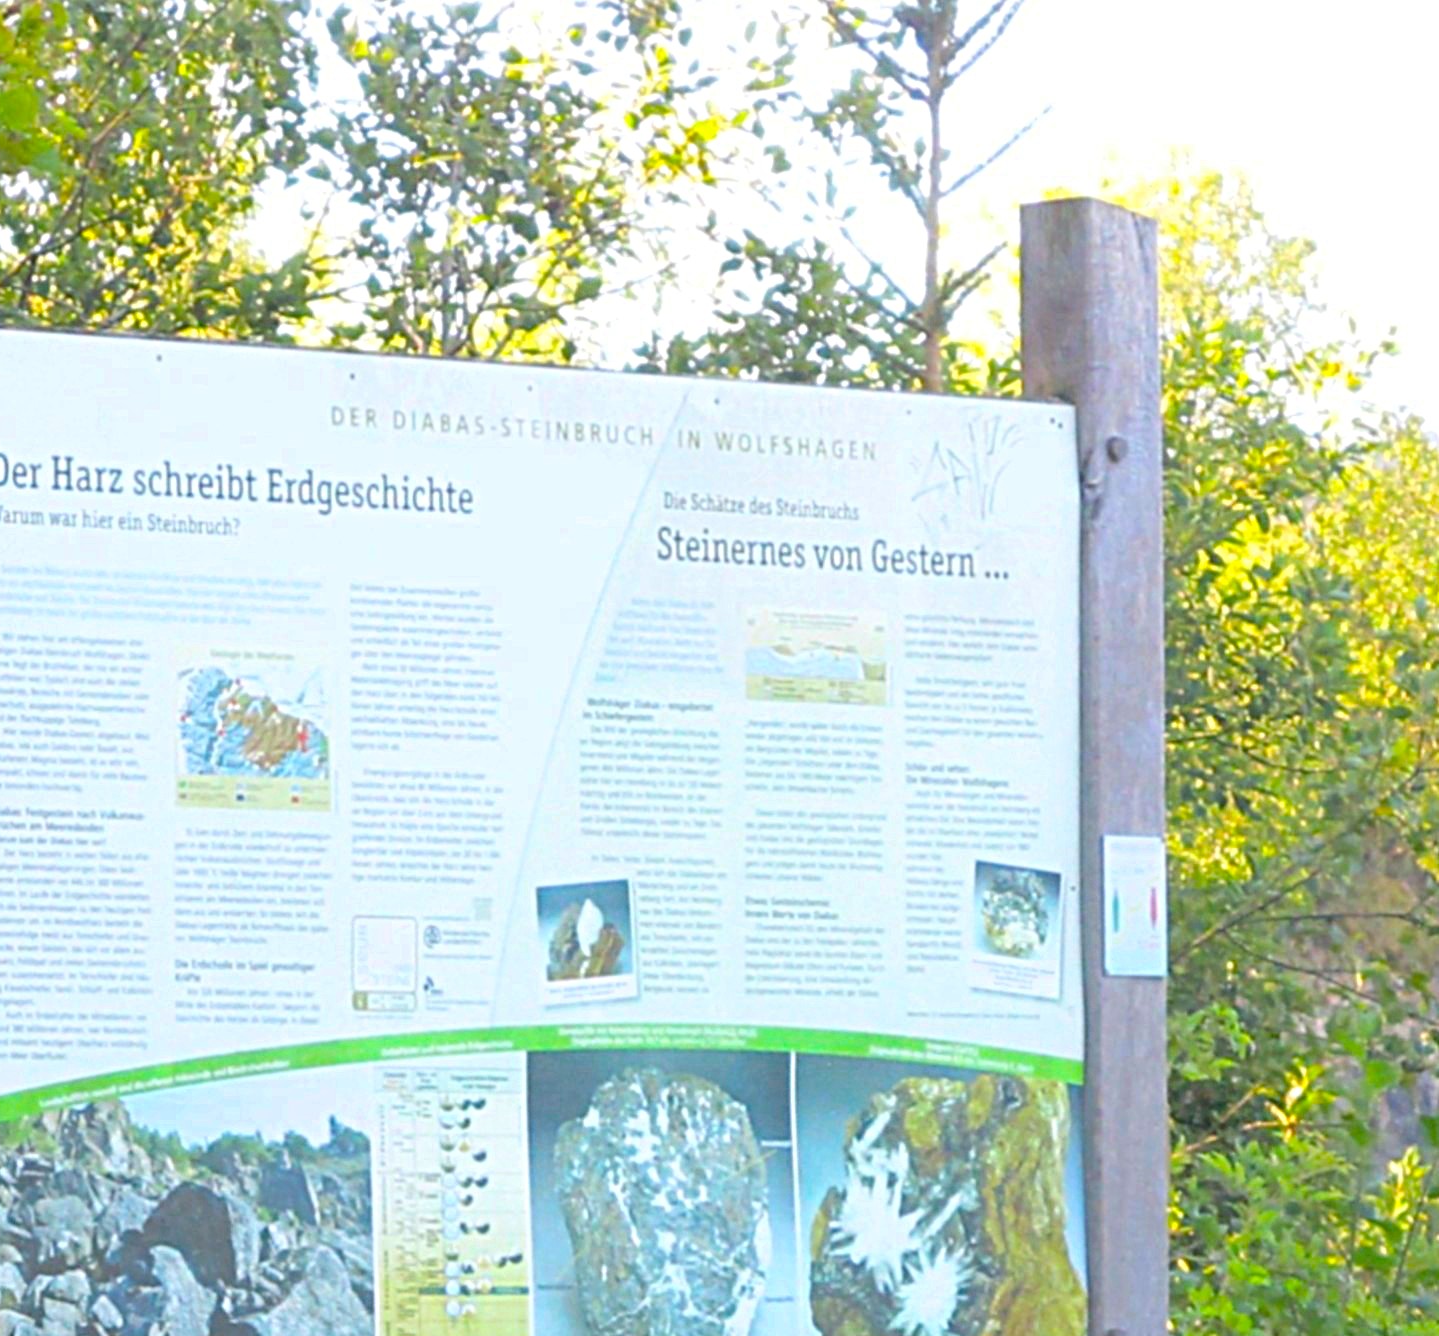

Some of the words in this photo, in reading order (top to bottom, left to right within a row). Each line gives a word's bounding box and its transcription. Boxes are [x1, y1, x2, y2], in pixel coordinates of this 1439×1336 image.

[331, 406, 377, 428] DER
[393, 410, 653, 446] DIABAS-STEINBRUCH
[677, 430, 700, 449] IN
[714, 431, 876, 460] WOLFSHAGEN
[51, 455, 124, 494] Harz
[133, 460, 258, 501] schreibt
[267, 468, 474, 515] Erdgeschichte
[664, 492, 687, 509] Die
[691, 493, 744, 514] Schätze
[750, 497, 772, 515] des
[776, 499, 859, 520] Steinbruchs
[49, 511, 77, 527] war
[82, 509, 112, 529] hier
[118, 512, 143, 531] ein
[147, 513, 240, 536] Steinbruch?
[657, 526, 806, 568] Steinernes
[813, 544, 863, 571] von
